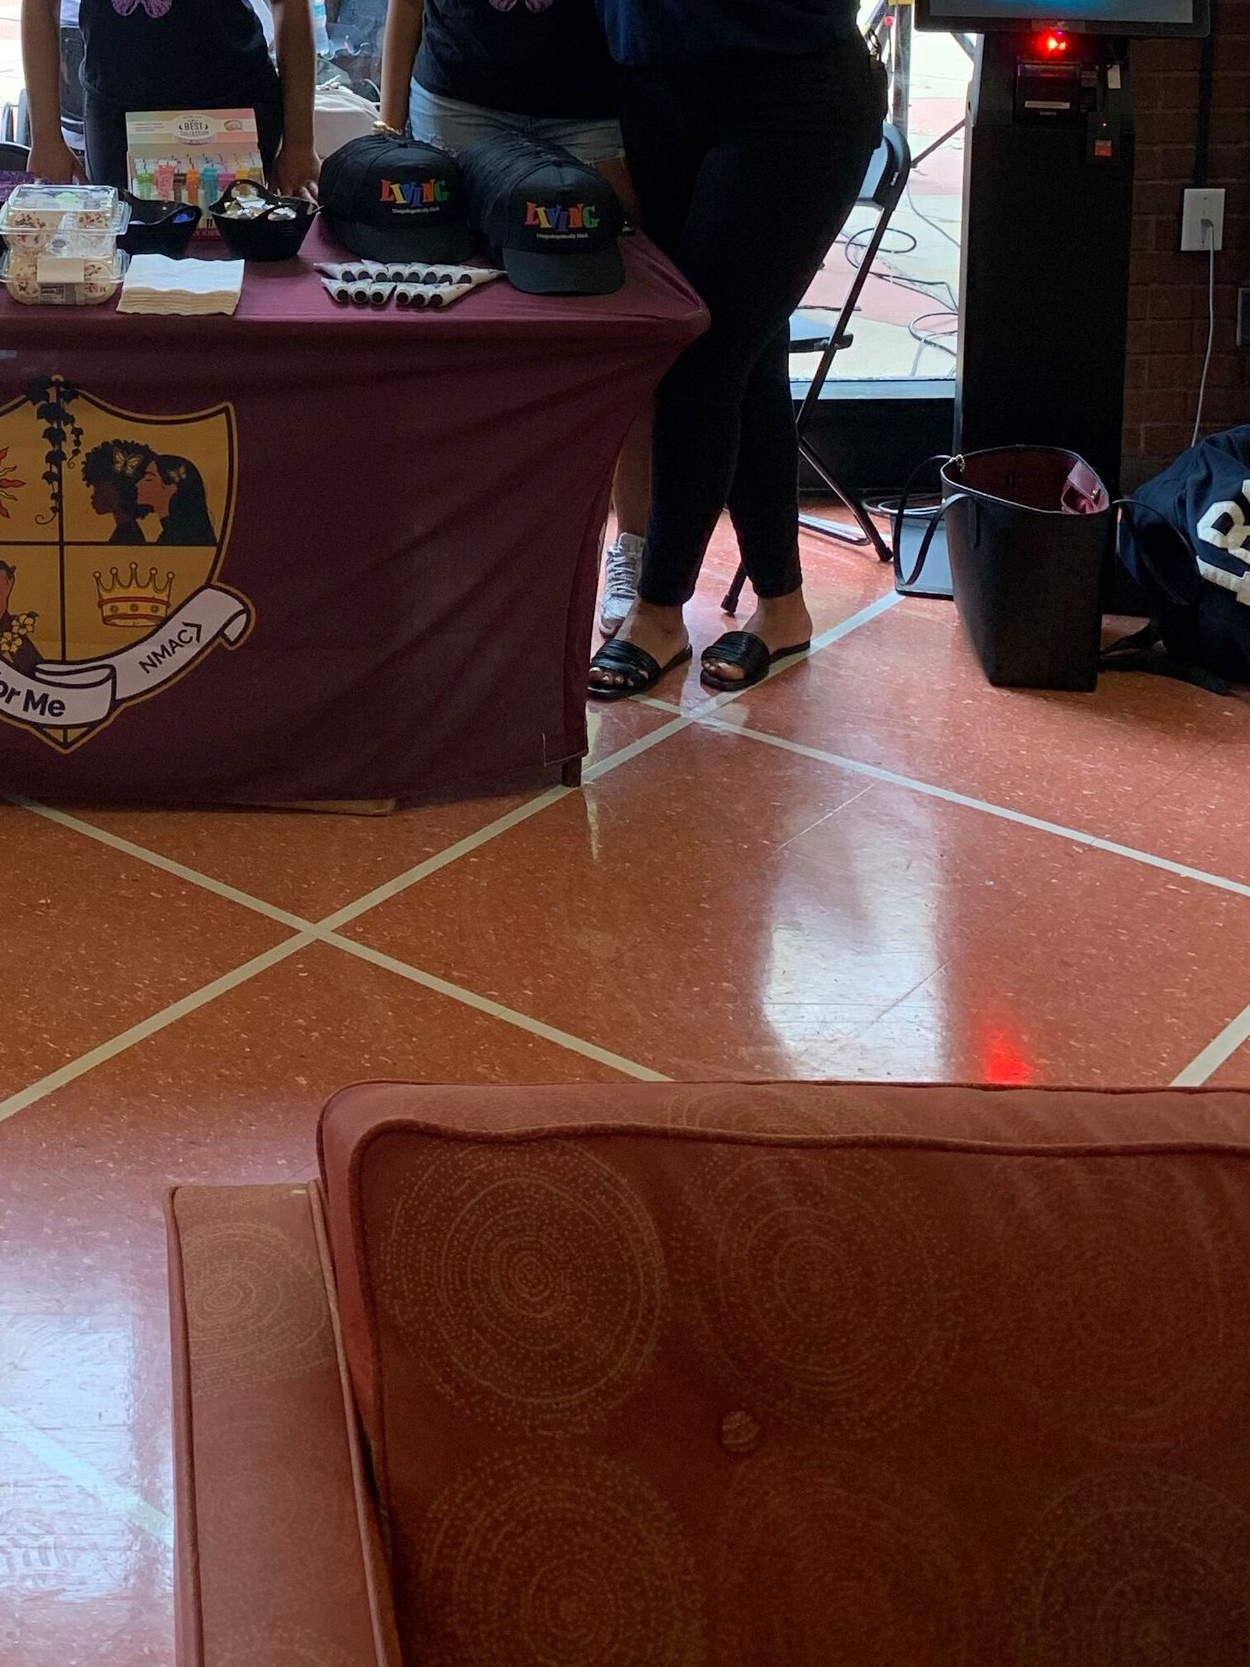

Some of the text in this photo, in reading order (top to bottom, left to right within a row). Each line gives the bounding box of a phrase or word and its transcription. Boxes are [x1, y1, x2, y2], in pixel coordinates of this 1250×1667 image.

[184, 122, 204, 131] BEST
[380, 178, 449, 208] LIVING
[524, 201, 600, 232] LIVING
[138, 629, 193, 675] NMAC
[22, 689, 66, 718] Me
